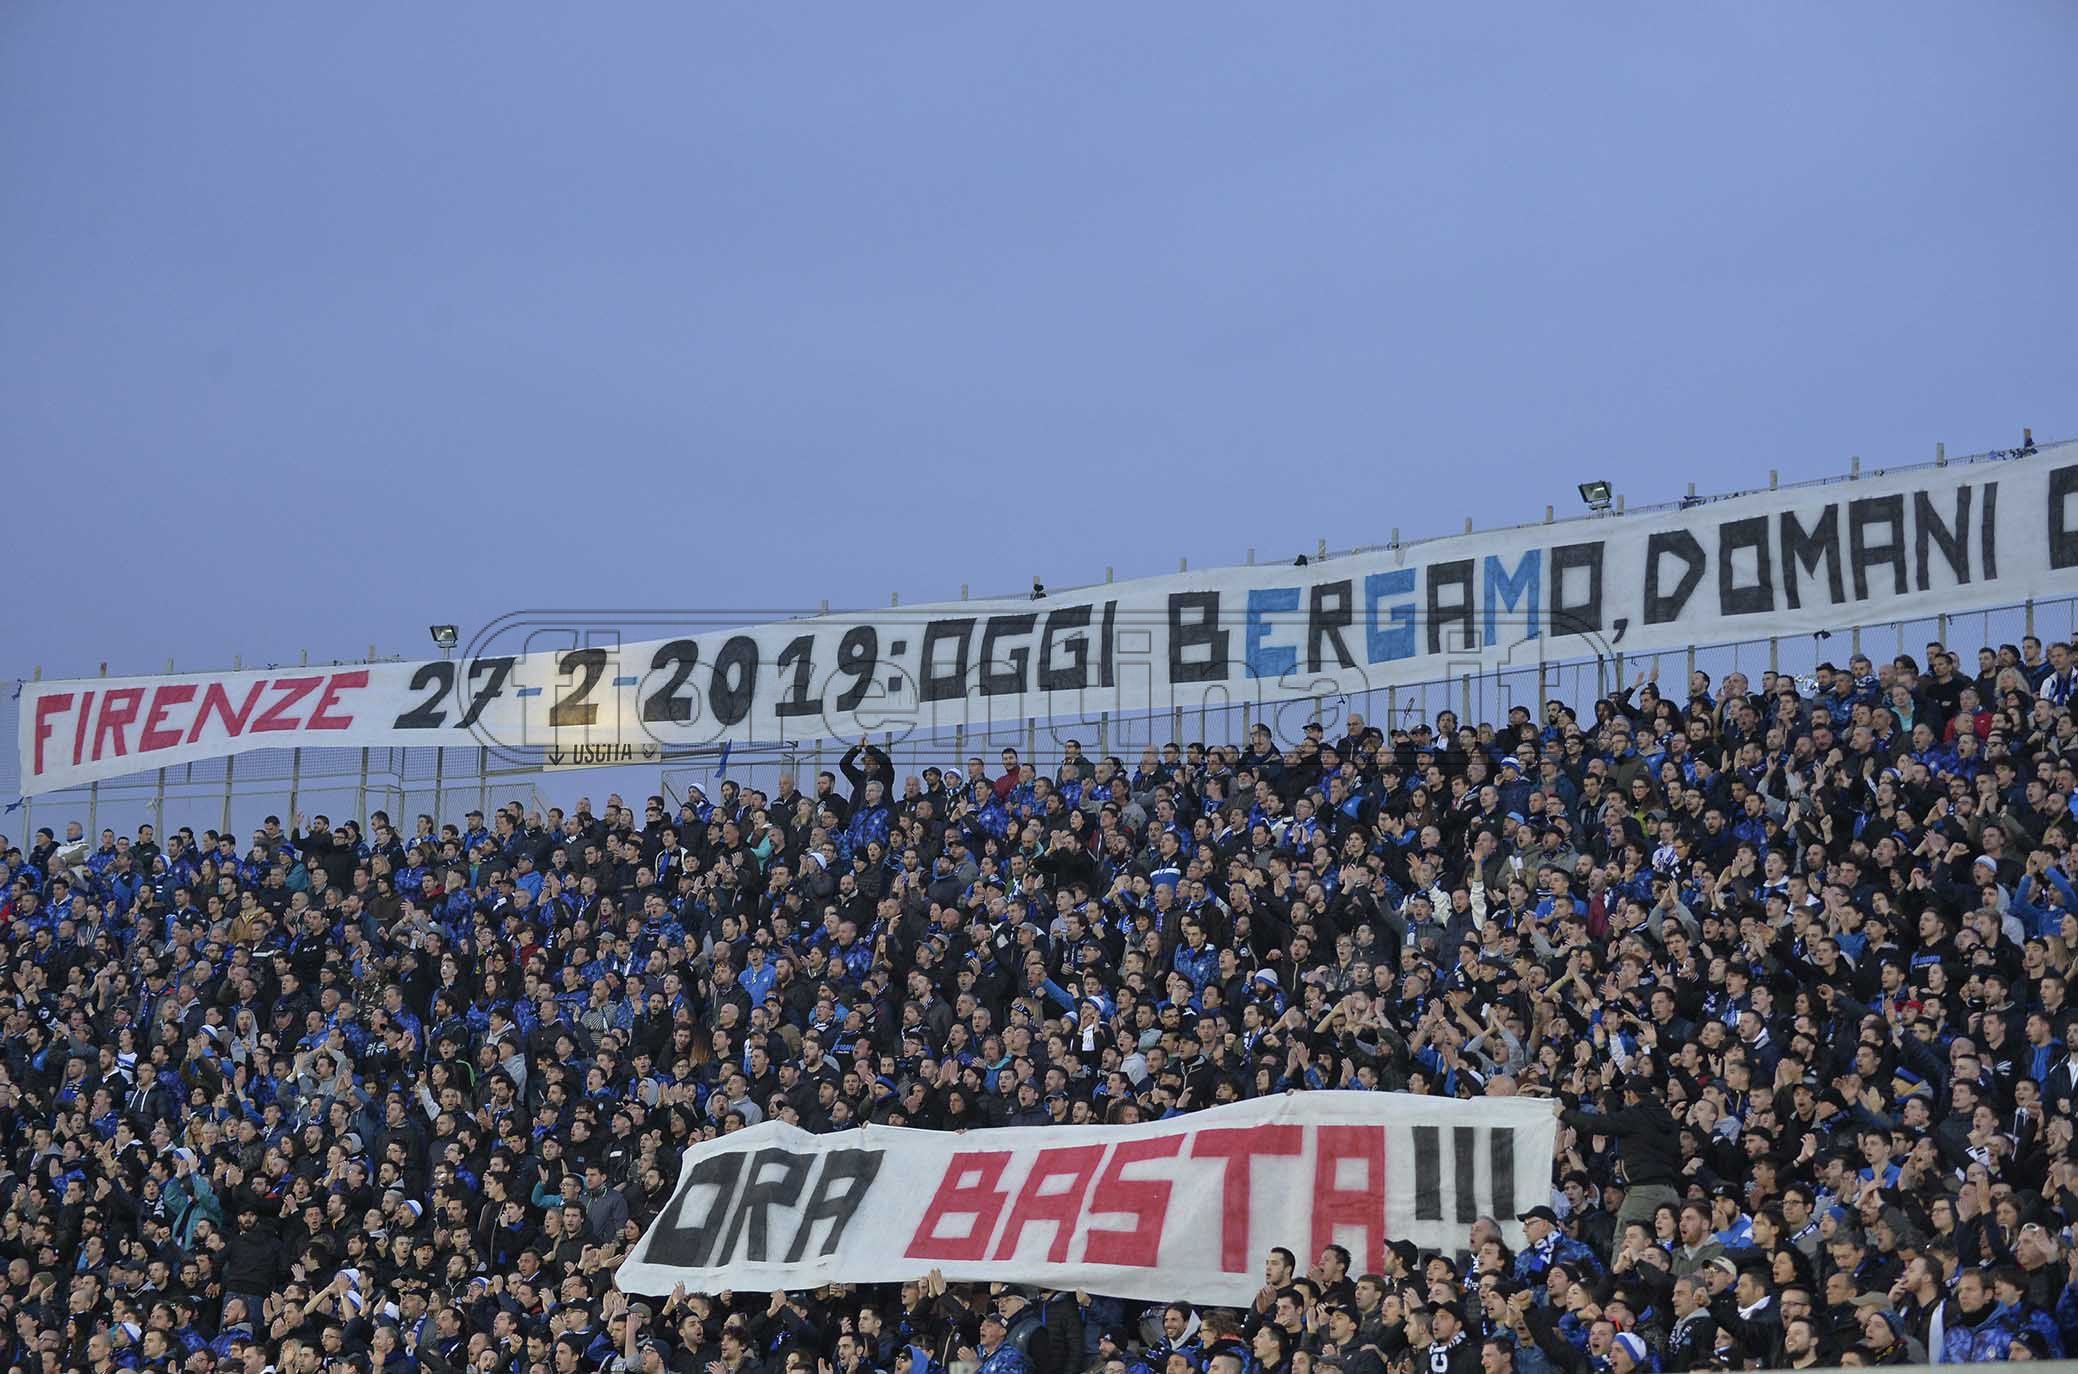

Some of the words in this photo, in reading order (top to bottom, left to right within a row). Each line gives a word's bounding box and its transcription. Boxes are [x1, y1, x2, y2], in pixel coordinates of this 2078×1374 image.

[34, 670, 370, 776] FIRENZE
[919, 600, 1118, 702] OGGI
[1168, 541, 1628, 684] BERGAMO,
[1643, 482, 1999, 625] DOMANI
[573, 744, 633, 765] USCITA
[643, 1147, 886, 1268] ORA
